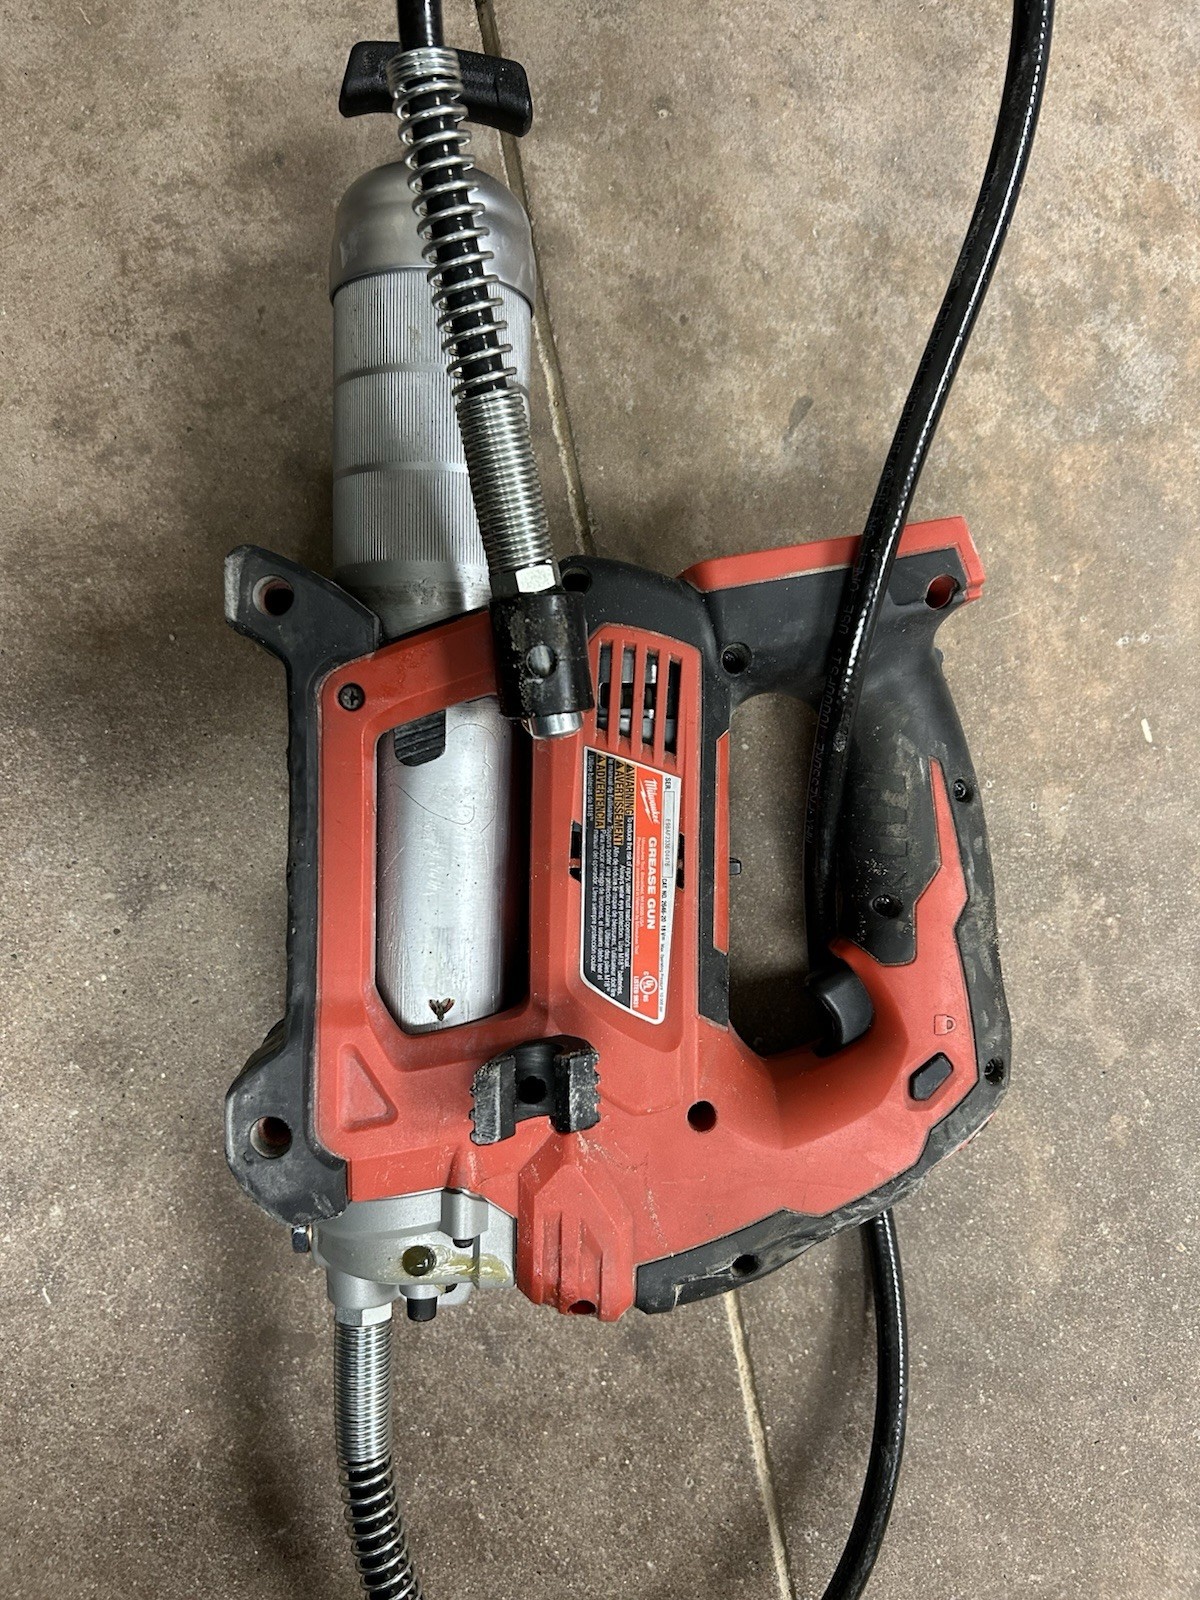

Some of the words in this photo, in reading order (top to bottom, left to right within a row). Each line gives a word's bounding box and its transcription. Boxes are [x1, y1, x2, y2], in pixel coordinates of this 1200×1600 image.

[596, 764, 605, 827] ADVERTENCIA
[614, 771, 624, 843] AVERTISSEMENT
[625, 773, 634, 814] WARNING
[644, 778, 660, 824] Milwaukee
[618, 865, 626, 884] Always
[648, 837, 657, 894] GREASE
[612, 910, 618, 918] de
[647, 898, 656, 929] GUN
